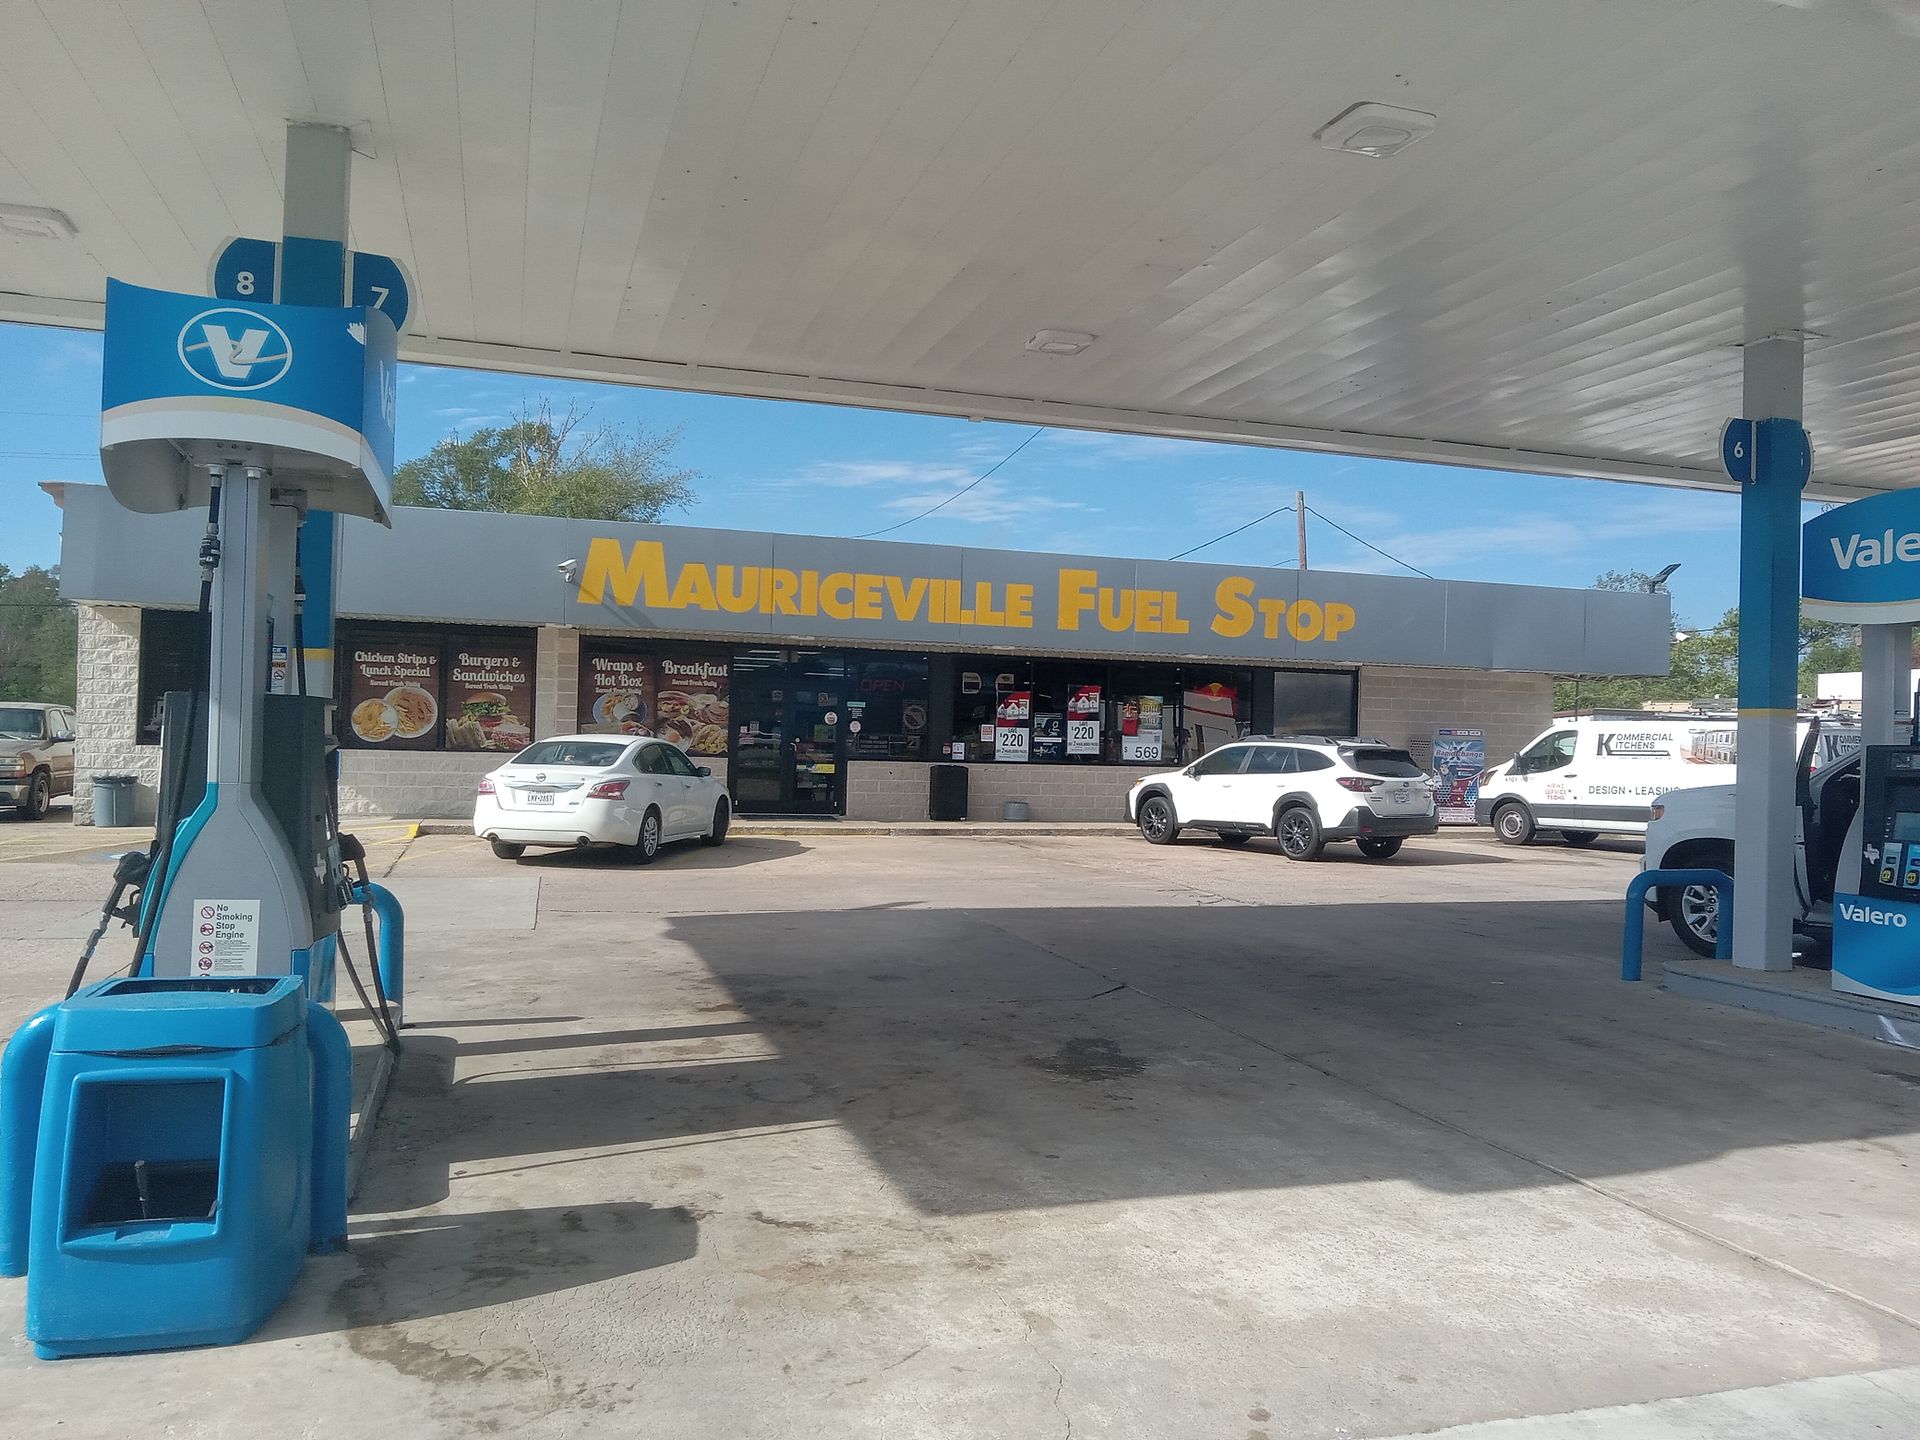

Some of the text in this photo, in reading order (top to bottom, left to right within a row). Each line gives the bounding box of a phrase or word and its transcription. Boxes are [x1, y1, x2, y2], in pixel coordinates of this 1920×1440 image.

[236, 271, 255, 295] 8
[370, 286, 390, 309] 7
[1733, 441, 1744, 459] 6
[577, 537, 1356, 642] MAURICEVILLE FUEL STOP
[354, 650, 437, 665] Chicken Strips &
[458, 653, 521, 670] Burgers &
[359, 664, 431, 678] Lunch Special
[591, 657, 645, 675] Wraps &
[662, 659, 729, 679] Breakfast
[452, 668, 526, 683] Sandwiches
[594, 673, 644, 687] Hot Box
[860, 678, 905, 692] OPEN
[1588, 785, 1626, 795] DESIGN
[216, 904, 229, 912] No
[1839, 903, 1907, 928] Valero
[216, 913, 253, 922] Smoking
[216, 922, 235, 931] Stop
[215, 930, 245, 940] Engine
